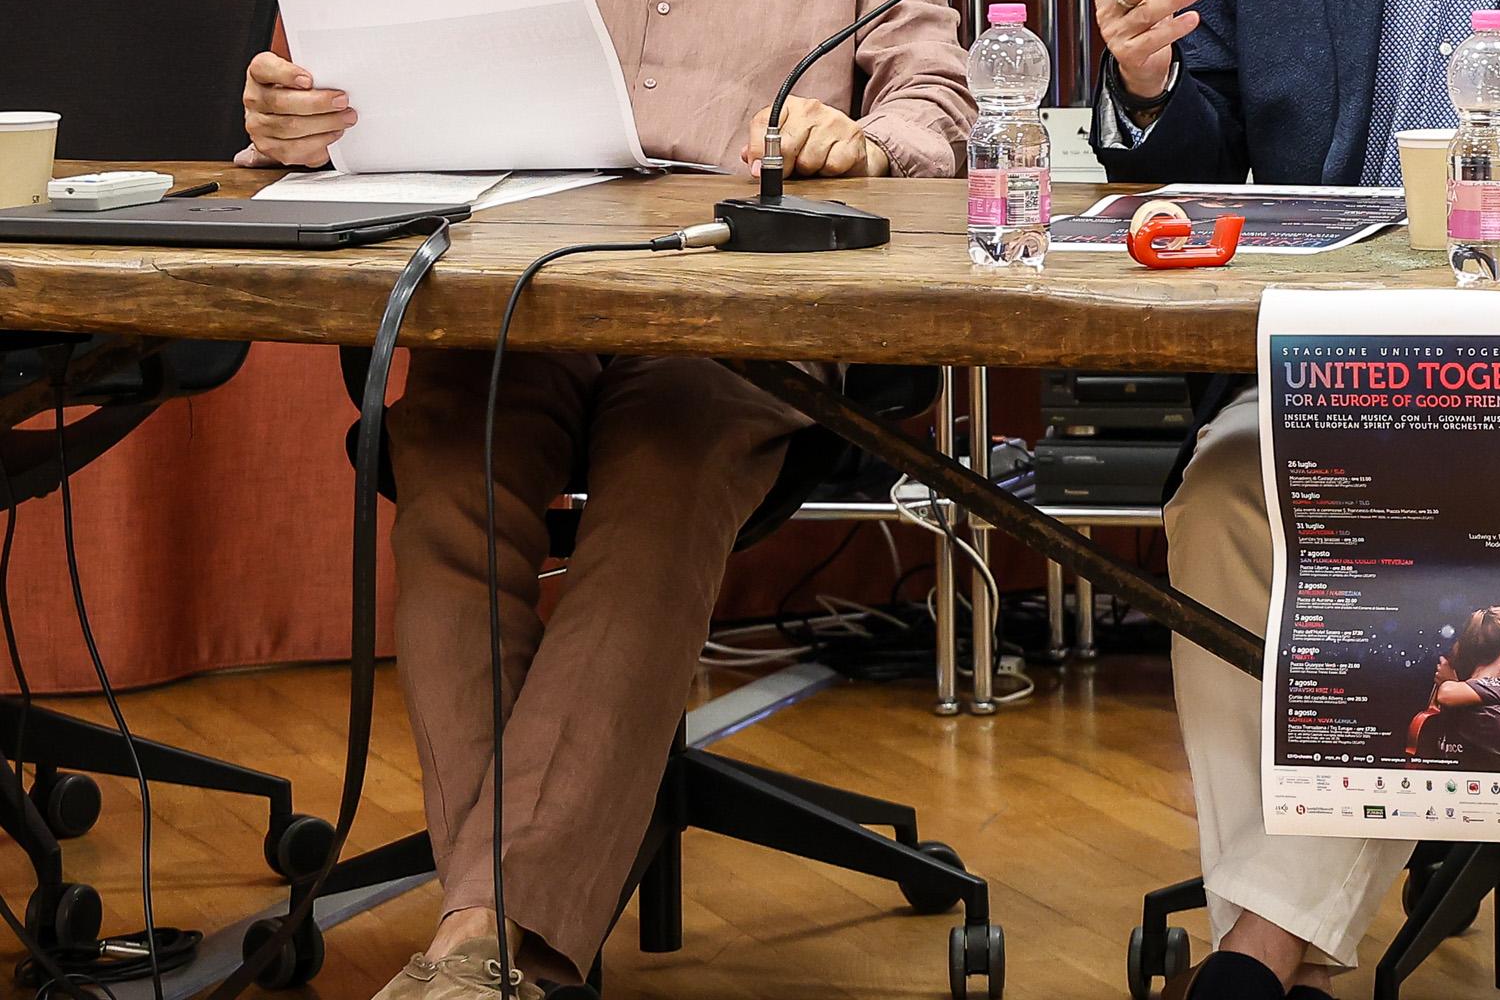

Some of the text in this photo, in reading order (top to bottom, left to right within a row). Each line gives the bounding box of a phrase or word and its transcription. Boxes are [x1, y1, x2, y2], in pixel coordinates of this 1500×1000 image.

[1282, 347, 1368, 356] STAGIONE
[1380, 347, 1444, 357] UNITED
[1283, 361, 1411, 390] UNITED
[1284, 393, 1314, 408] FOR
[1316, 393, 1328, 408] A
[1330, 393, 1389, 408] EUROPE
[1392, 394, 1413, 408] OF
[1415, 394, 1462, 409] GOOD
[1284, 413, 1319, 421] INSIEME
[1326, 414, 1353, 422] NELLA
[1360, 414, 1394, 422] MUSICA
[1400, 414, 1421, 422] CON
[1438, 415, 1476, 423] GIOVANI
[1284, 421, 1311, 429] DELLA
[1314, 421, 1360, 429] EUROPEAN
[1363, 422, 1391, 430] SPIRIT
[1394, 422, 1406, 430] OF
[1408, 422, 1439, 430] YOUTH
[1443, 423, 1495, 431] ORCHESTRA
[1287, 460, 1317, 469] 26 luglio
[1301, 492, 1321, 500] luglio
[1296, 522, 1325, 531] 31 luglio
[1468, 533, 1492, 541] Ludwig
[1307, 550, 1331, 558] agosto
[1304, 582, 1328, 590] agosto
[1300, 614, 1324, 623] agosto
[1296, 646, 1320, 655] agosto
[1294, 679, 1318, 687] agosto
[1294, 709, 1317, 717] agosto
